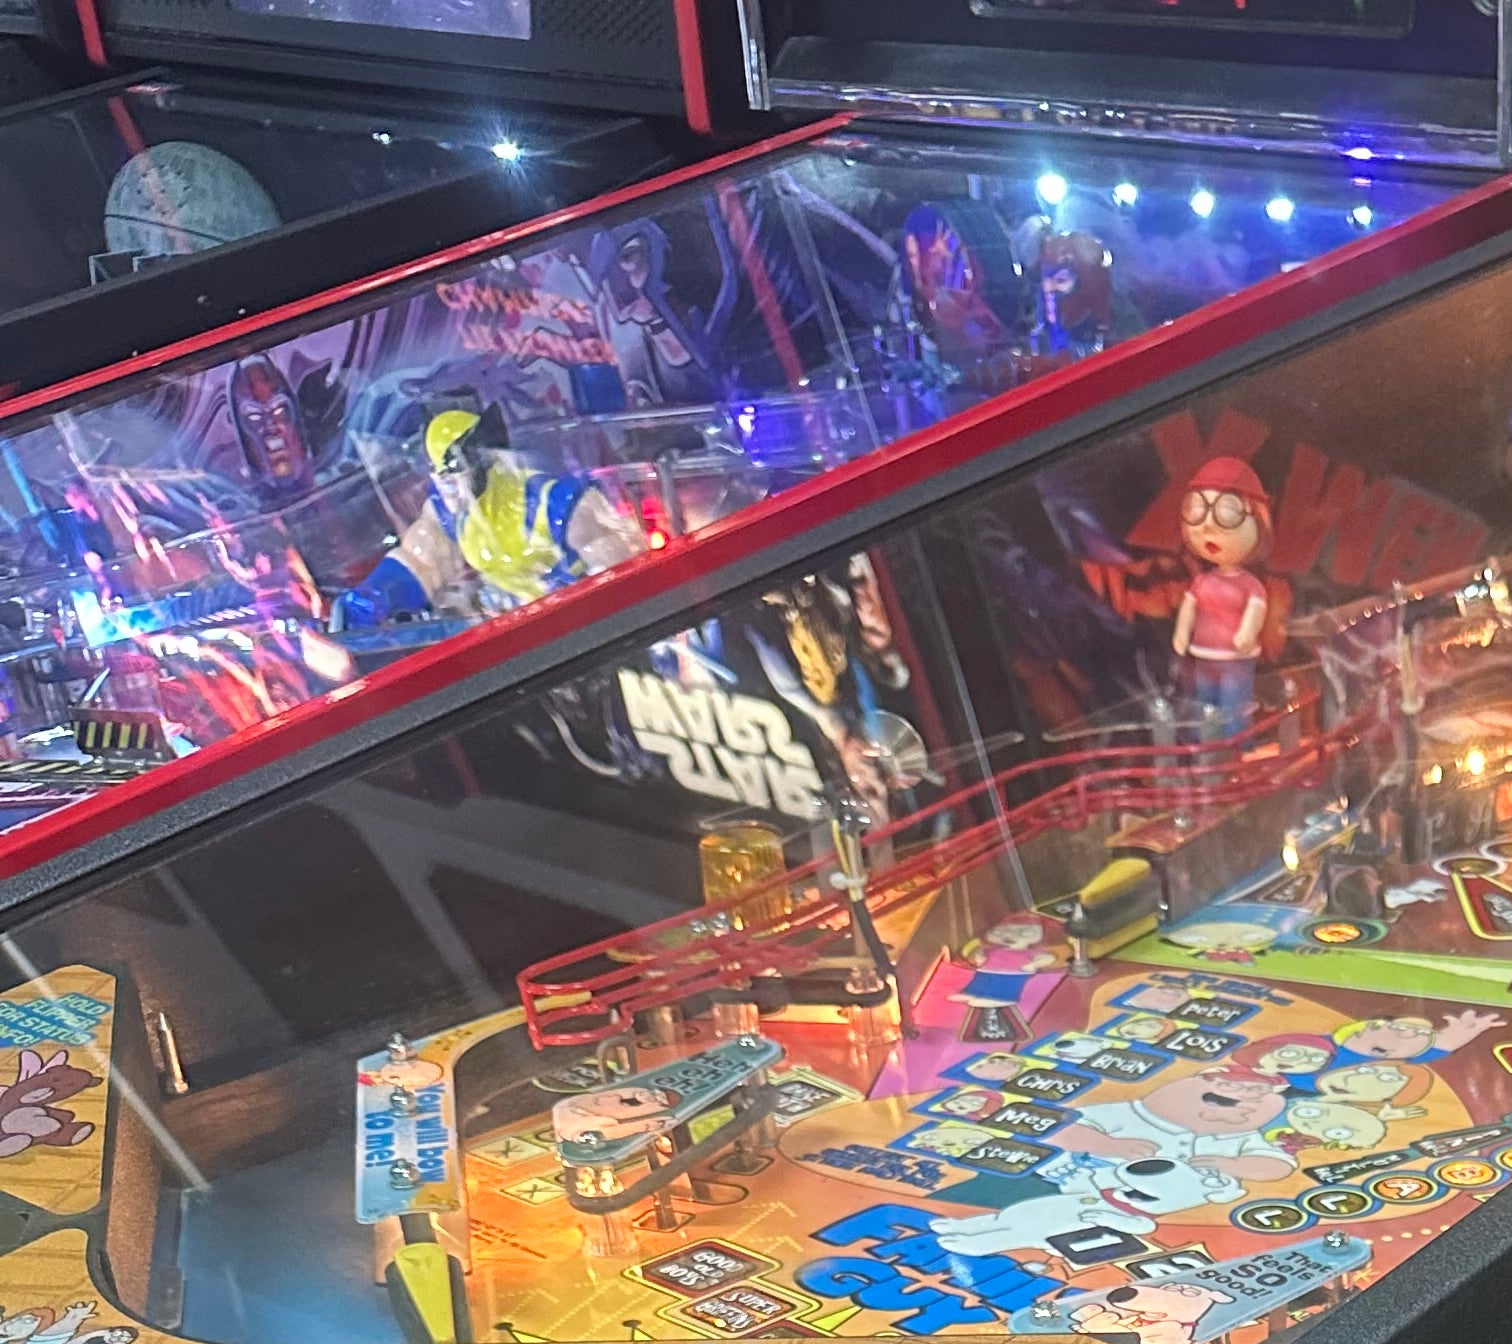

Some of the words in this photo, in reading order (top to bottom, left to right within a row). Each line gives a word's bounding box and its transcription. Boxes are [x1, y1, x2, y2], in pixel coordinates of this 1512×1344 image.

[59, 994, 107, 1015] HOLD
[18, 1016, 92, 1045] STATUS
[416, 1115, 449, 1145] will
[995, 1109, 1057, 1131] Meg
[365, 1131, 395, 1169] me!
[417, 1145, 450, 1182] bow
[693, 1249, 745, 1273] GOOD
[1251, 1254, 1316, 1281] feels
[1285, 1251, 1334, 1274] That
[659, 1264, 706, 1287] BOYS
[1196, 1269, 1273, 1299] good!
[720, 1291, 782, 1316] SUPER
[800, 1257, 1003, 1336] GUY
